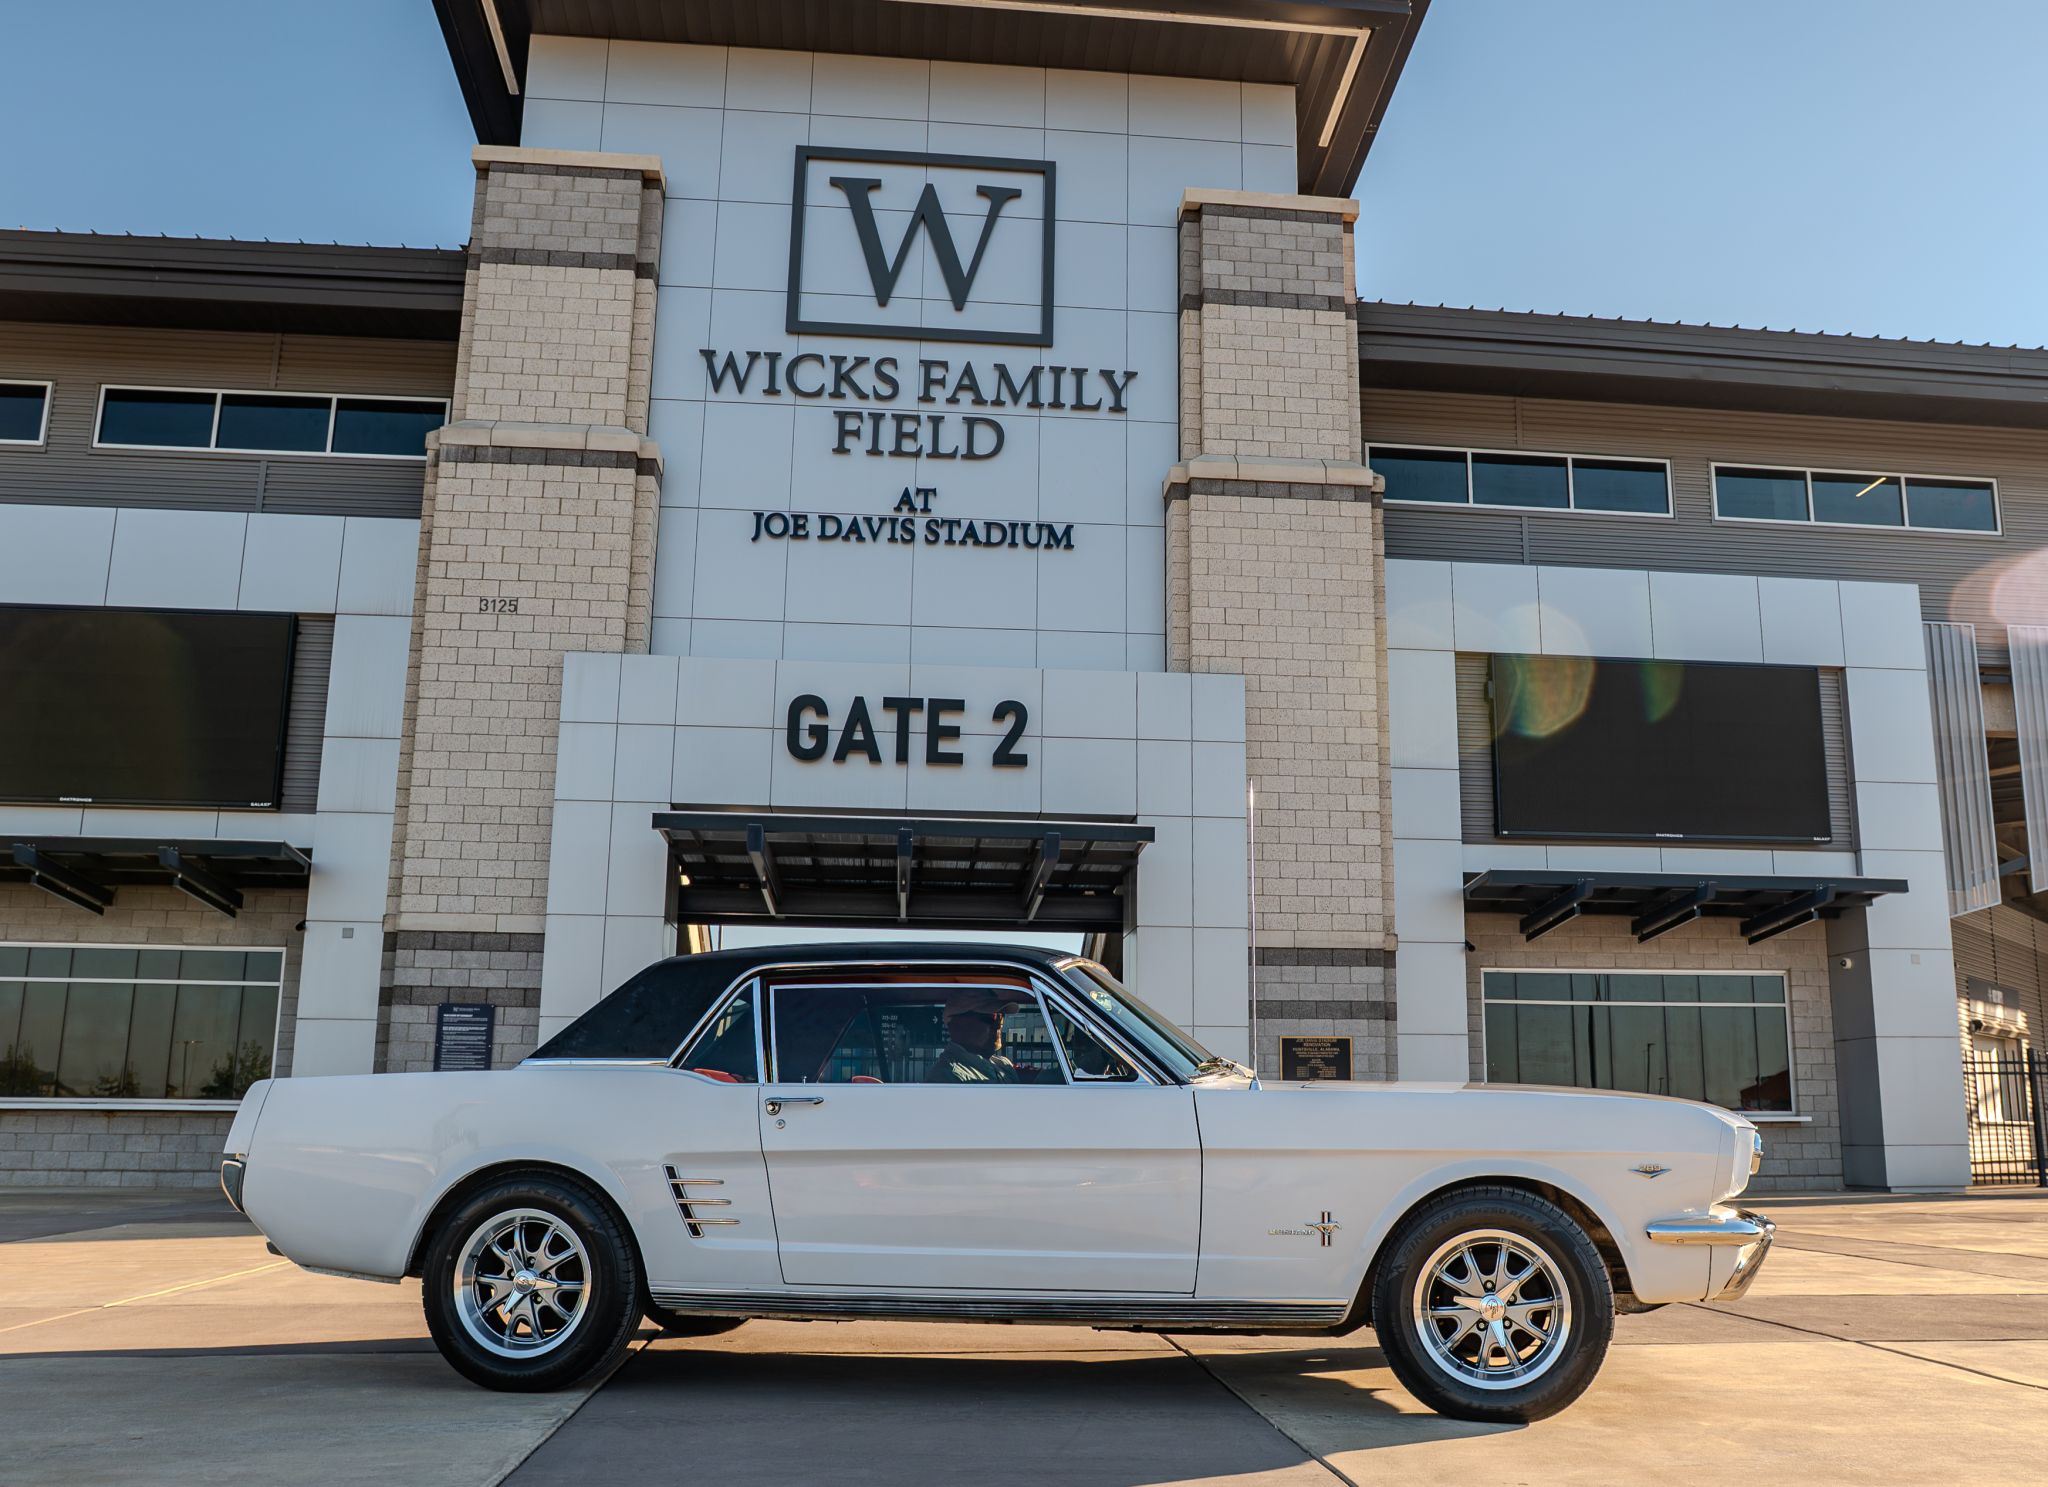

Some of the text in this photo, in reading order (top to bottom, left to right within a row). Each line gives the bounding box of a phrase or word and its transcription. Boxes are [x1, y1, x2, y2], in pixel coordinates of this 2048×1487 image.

[829, 176, 1022, 311] W
[699, 348, 1138, 413] WICKS FAMILY
[831, 409, 1005, 460] FIELD
[893, 486, 937, 514] AT
[750, 511, 1075, 550] JOE DAVIS STADIUM
[480, 598, 517, 613] 3125
[787, 694, 1028, 767] GATE 2
